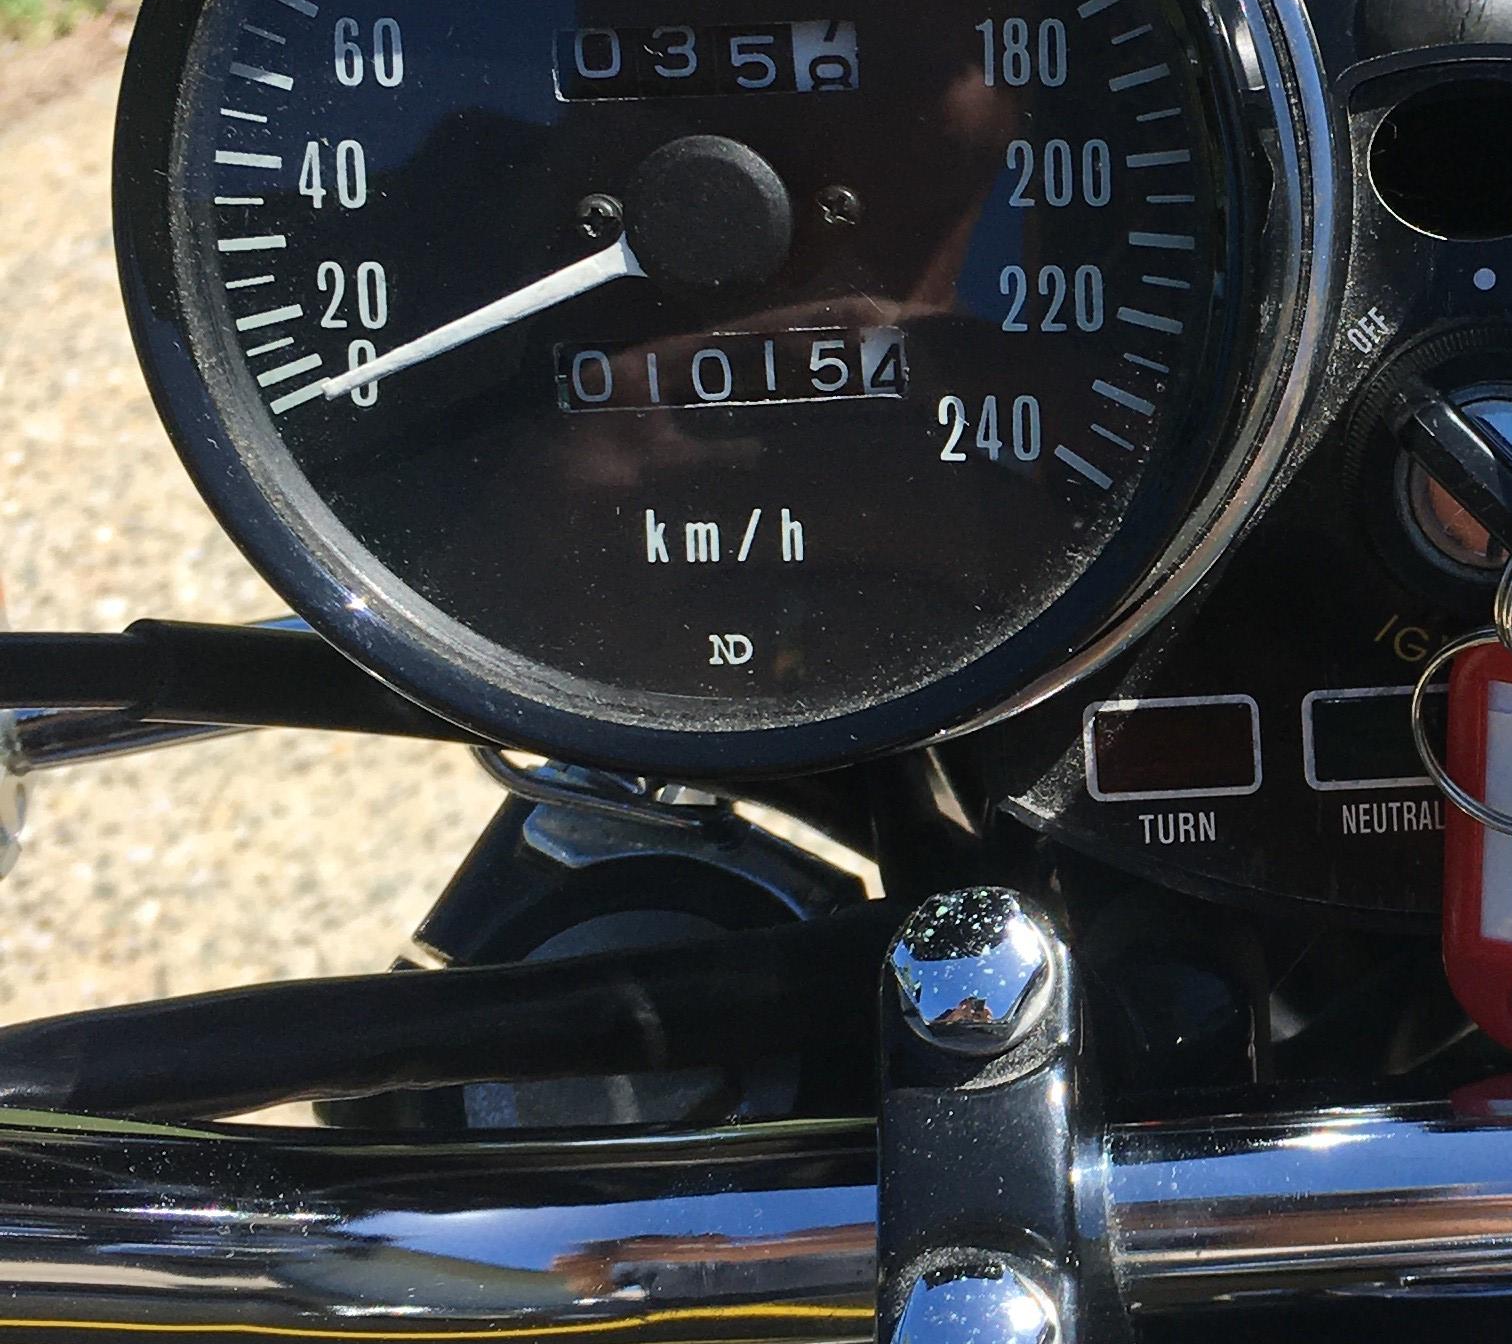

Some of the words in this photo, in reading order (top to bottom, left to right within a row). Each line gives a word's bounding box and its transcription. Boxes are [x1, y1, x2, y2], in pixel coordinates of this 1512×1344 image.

[332, 17, 404, 88] 60
[975, 17, 1069, 88] 180
[298, 139, 367, 209] 40
[1005, 139, 1112, 207] 200
[316, 261, 388, 330] 20
[999, 265, 1105, 333] 220
[1347, 306, 1389, 354] OFF
[347, 338, 379, 408] 0
[938, 394, 1042, 462] 240
[646, 508, 805, 563] km/h
[709, 634, 754, 665] ND
[1138, 811, 1217, 845] TURN
[1342, 800, 1446, 835] NEUTRAL
